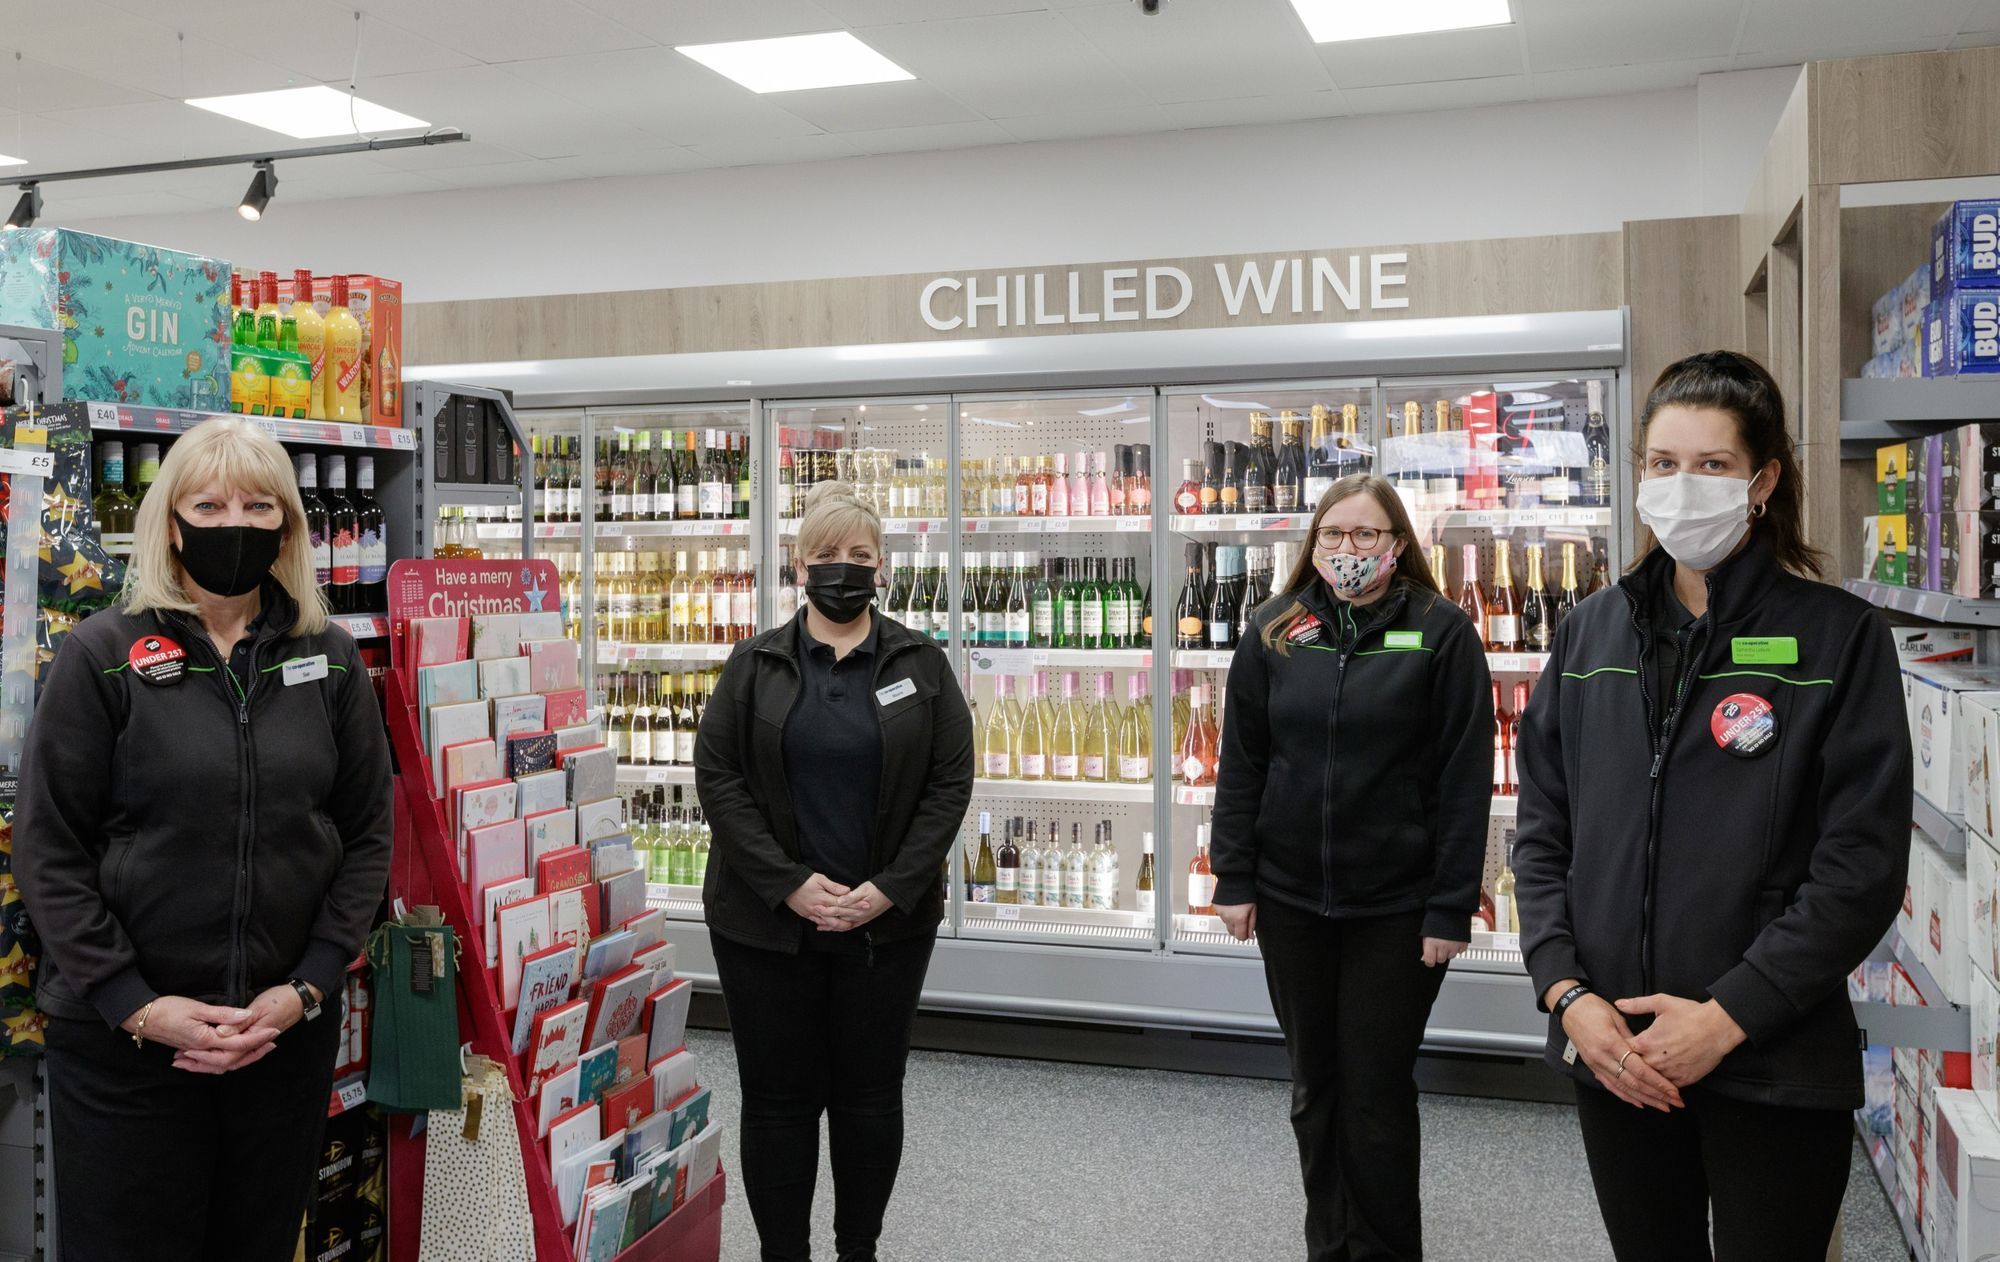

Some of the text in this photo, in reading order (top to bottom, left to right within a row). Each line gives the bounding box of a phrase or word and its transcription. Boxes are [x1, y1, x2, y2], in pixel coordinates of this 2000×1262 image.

[1973, 213, 1998, 270] BUD
[919, 252, 1410, 332] CHILLED WINE
[127, 306, 179, 345] GIN
[1973, 301, 1999, 357] BUD
[36, 413, 69, 425] CHRISTMAS
[97, 408, 116, 421] £40
[352, 429, 363, 441] £9
[397, 433, 412, 444] £15
[31, 456, 50, 468] £5
[435, 567, 513, 589] Have a merry
[428, 590, 523, 618] Christmas
[351, 622, 372, 633] £5.50
[1899, 642, 1934, 653] CARLING
[135, 648, 183, 667] UNDER 25?
[1720, 715, 1752, 743] UNDER
[1749, 703, 1767, 720] 25?
[0, 781, 17, 789] MERR
[550, 871, 589, 892] GRANDSON
[530, 973, 568, 1003] FRIEND
[535, 996, 558, 1014] HAPPY
[341, 1086, 364, 1103] £5.75
[318, 1154, 354, 1182] STRONGBOW
